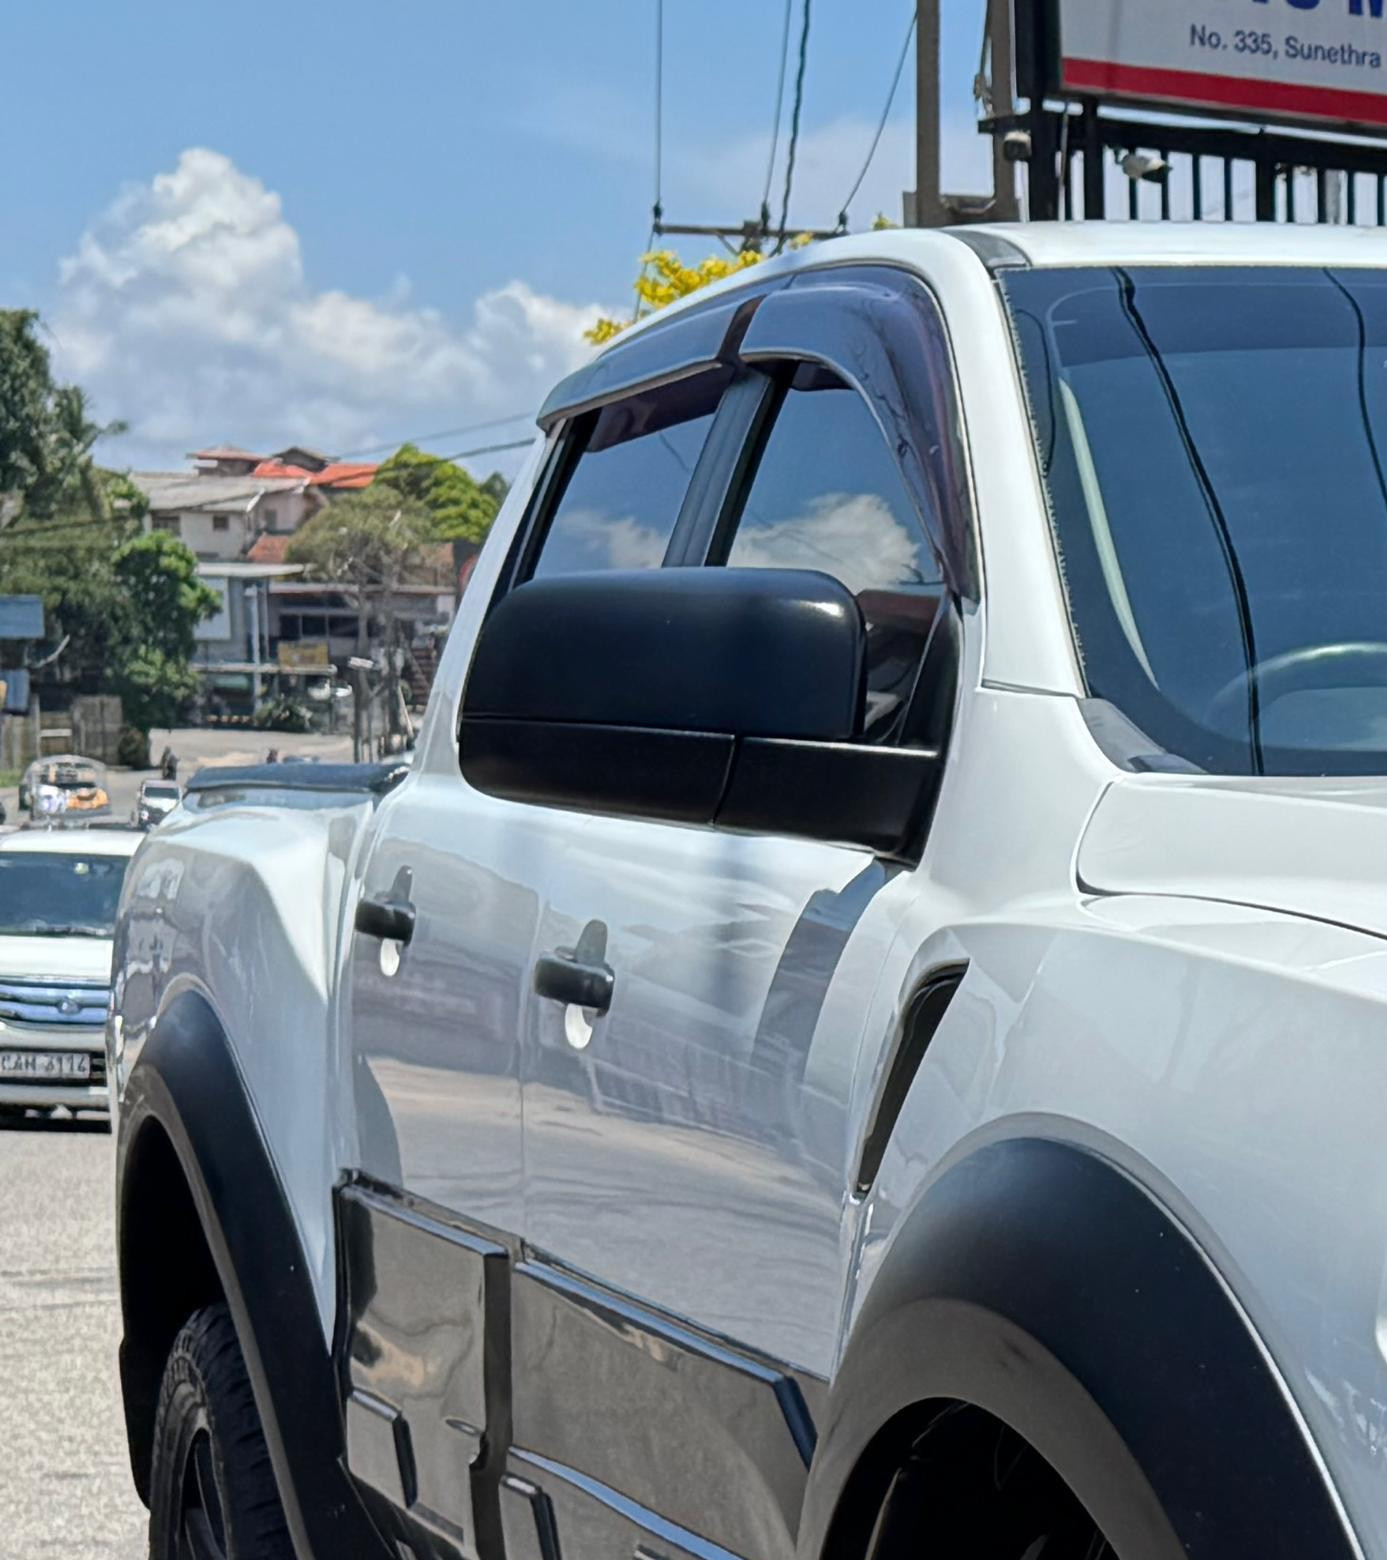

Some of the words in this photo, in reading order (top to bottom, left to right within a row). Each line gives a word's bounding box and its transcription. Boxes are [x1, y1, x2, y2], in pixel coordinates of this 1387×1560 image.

[1190, 24, 1227, 50] No.
[1234, 30, 1278, 60] 335,
[1285, 35, 1381, 68] Sunethra
